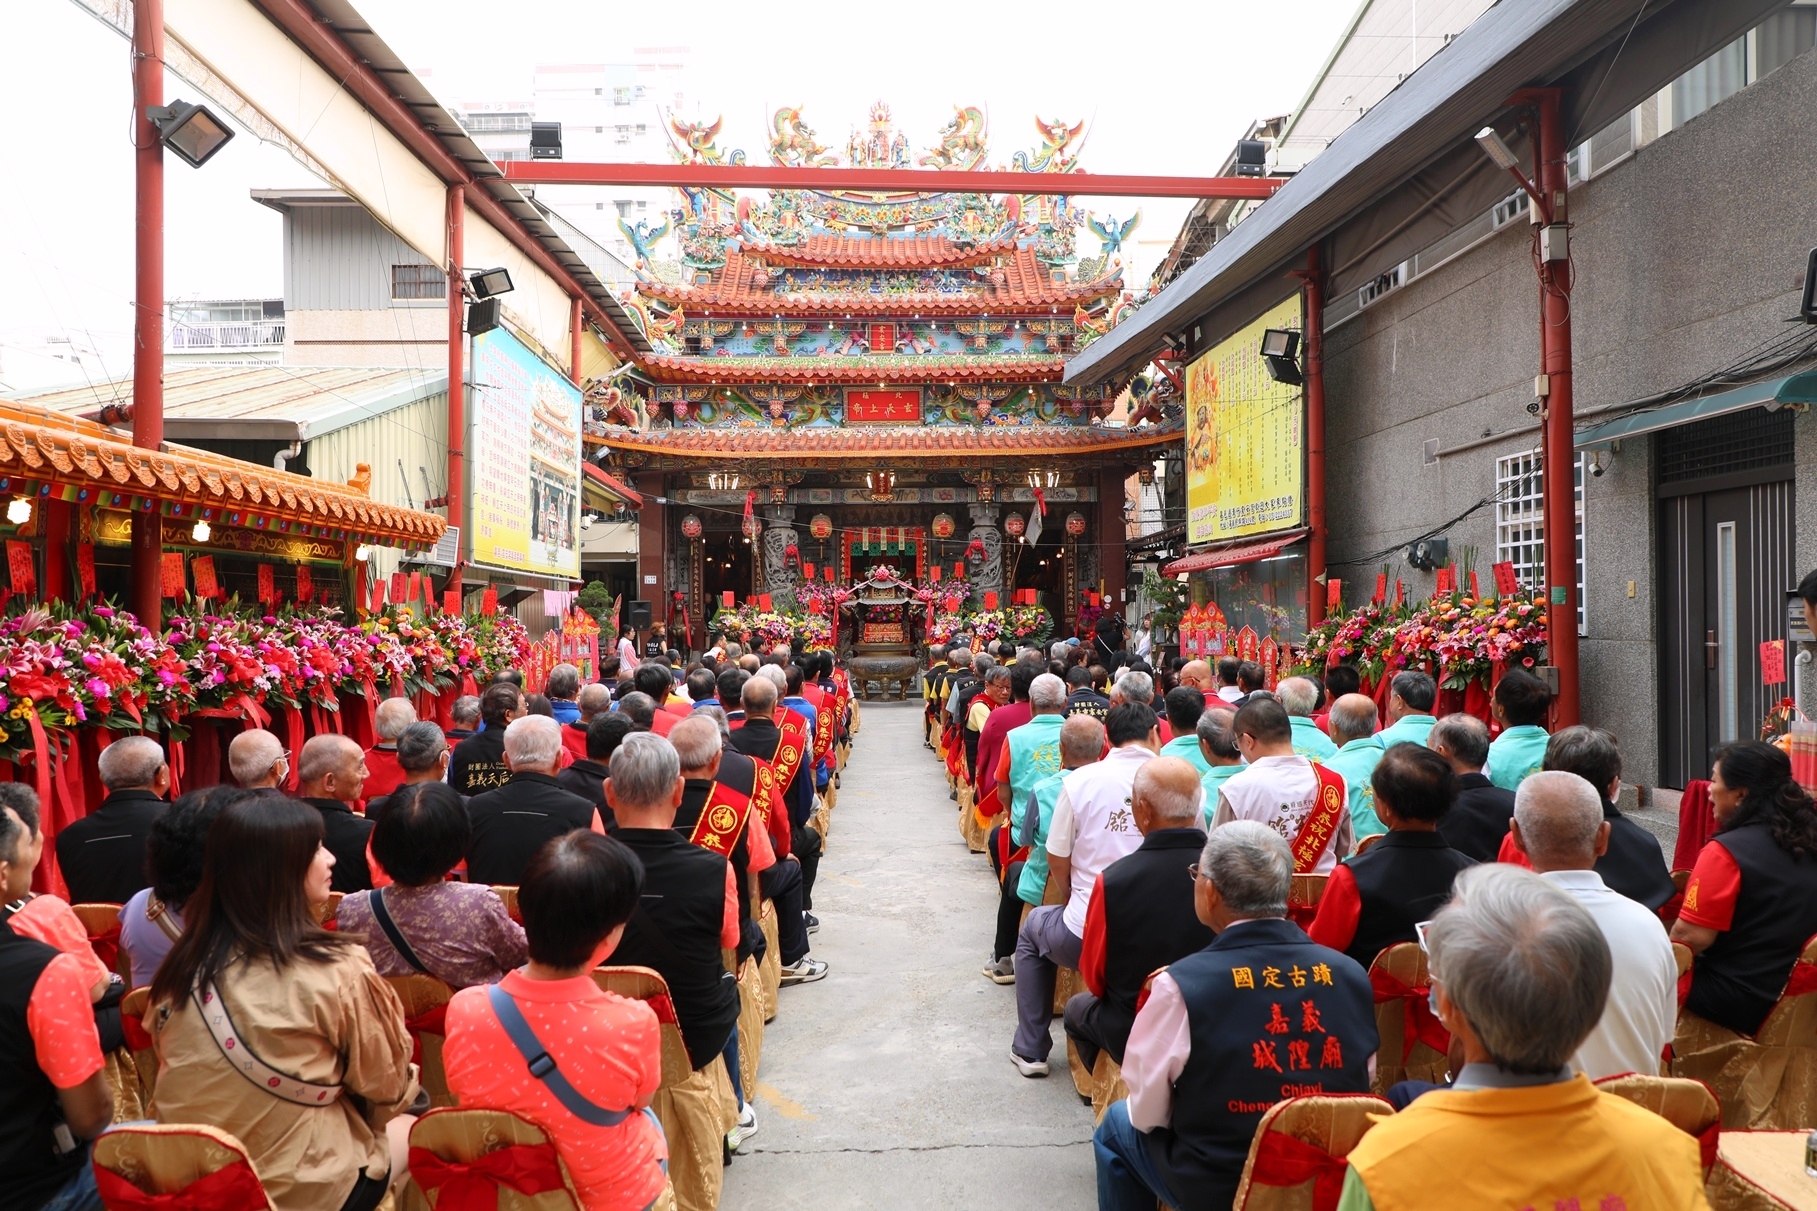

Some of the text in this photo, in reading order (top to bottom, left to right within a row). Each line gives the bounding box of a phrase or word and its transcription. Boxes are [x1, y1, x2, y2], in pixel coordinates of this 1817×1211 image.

[852, 402, 914, 415] 玄天上帝
[467, 762, 495, 771] 財團法人
[466, 771, 513, 788] 嘉義天后
[700, 832, 725, 851] 恭
[1231, 962, 1334, 989] 國定古蹟
[1264, 999, 1326, 1035] 嘉義
[1252, 1036, 1343, 1074] 城隍廟
